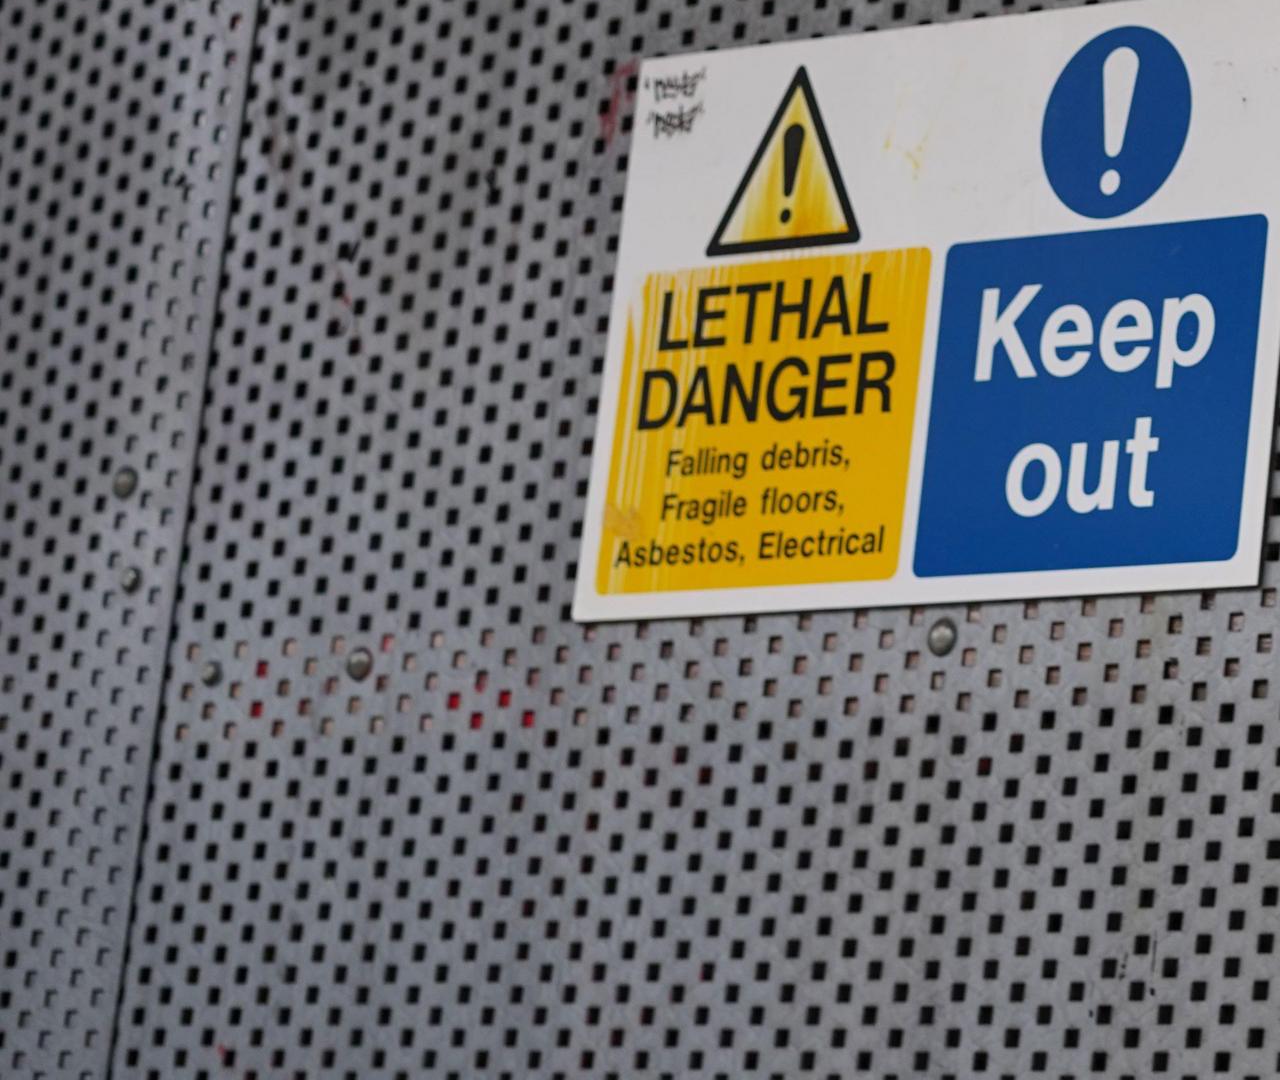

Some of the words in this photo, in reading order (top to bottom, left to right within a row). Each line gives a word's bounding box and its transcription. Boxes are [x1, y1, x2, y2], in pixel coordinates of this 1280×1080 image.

[658, 272, 890, 352] LETHAL
[973, 284, 1217, 389] Keep
[636, 350, 896, 432] DANGER
[665, 447, 749, 480] Falling
[760, 439, 851, 471] debris,
[1004, 416, 1160, 518] out
[613, 538, 746, 569] Asbestos,
[757, 525, 886, 561] Electrical
[660, 490, 748, 527] Fragile
[760, 487, 845, 516] floors,
